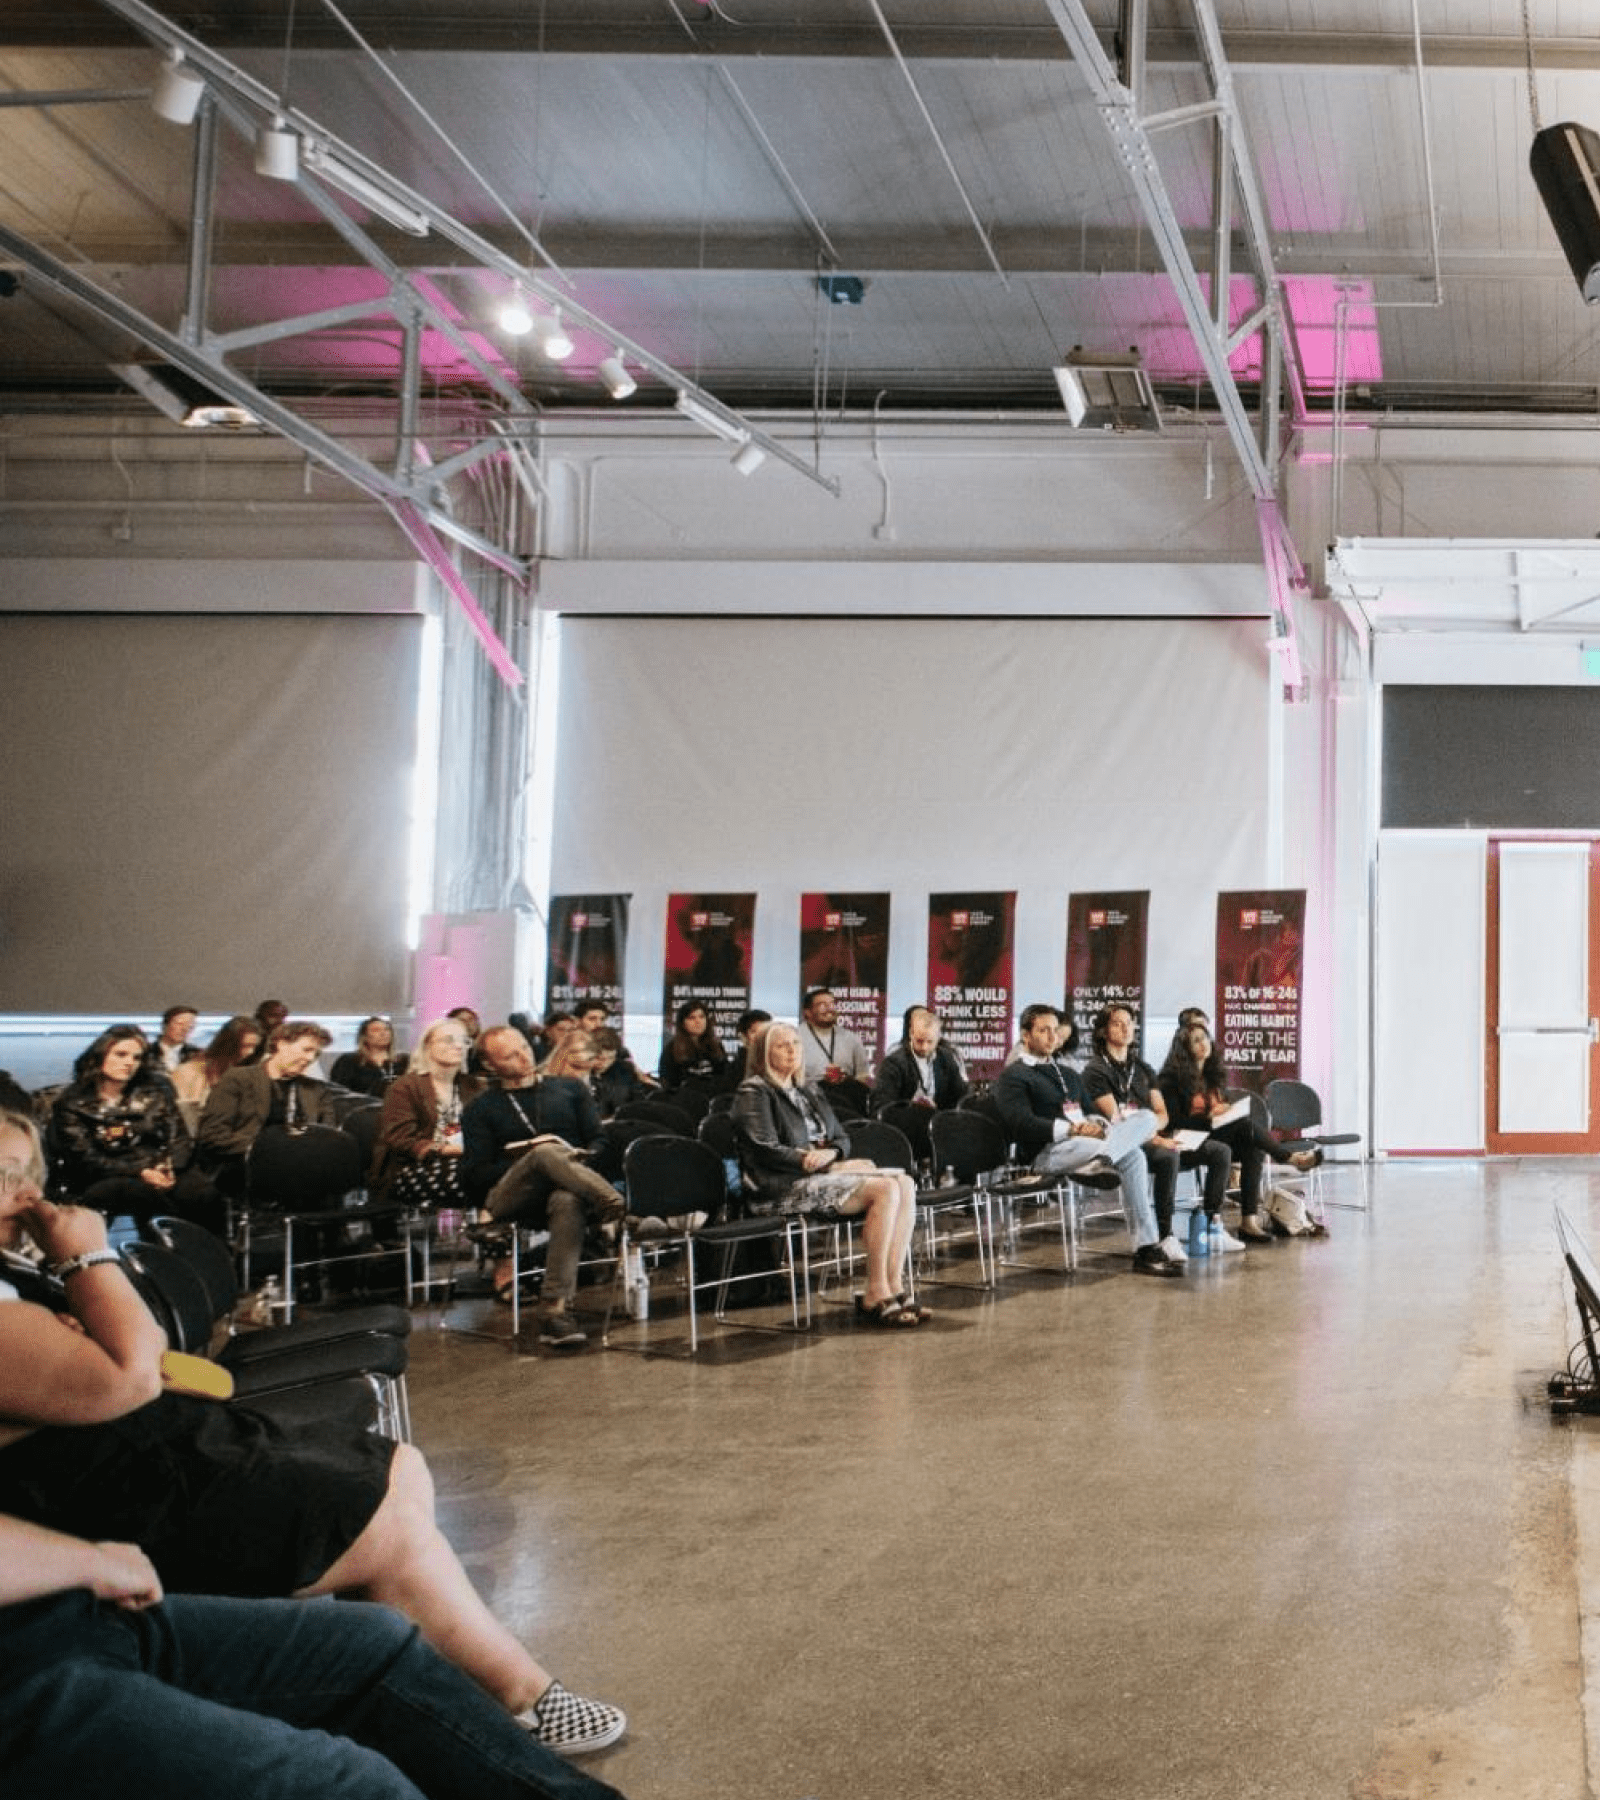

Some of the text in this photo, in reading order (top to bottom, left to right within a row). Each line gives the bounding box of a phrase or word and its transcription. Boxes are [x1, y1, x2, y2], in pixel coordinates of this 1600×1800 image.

[692, 986, 721, 997] WOULD
[850, 987, 871, 998] USED
[873, 988, 879, 998] A
[934, 985, 1007, 1001] 88% WOULD
[1074, 985, 1141, 998] ONLY 14% OF
[1225, 986, 1247, 999] 83%
[1249, 988, 1261, 999] OF
[935, 1005, 1007, 1018] THINK LESS
[1225, 1014, 1297, 1028] EATING HABITS
[984, 1032, 1006, 1043] THE
[1224, 1031, 1297, 1046] OVER THE
[1224, 1048, 1297, 1063] PAST YEAR
